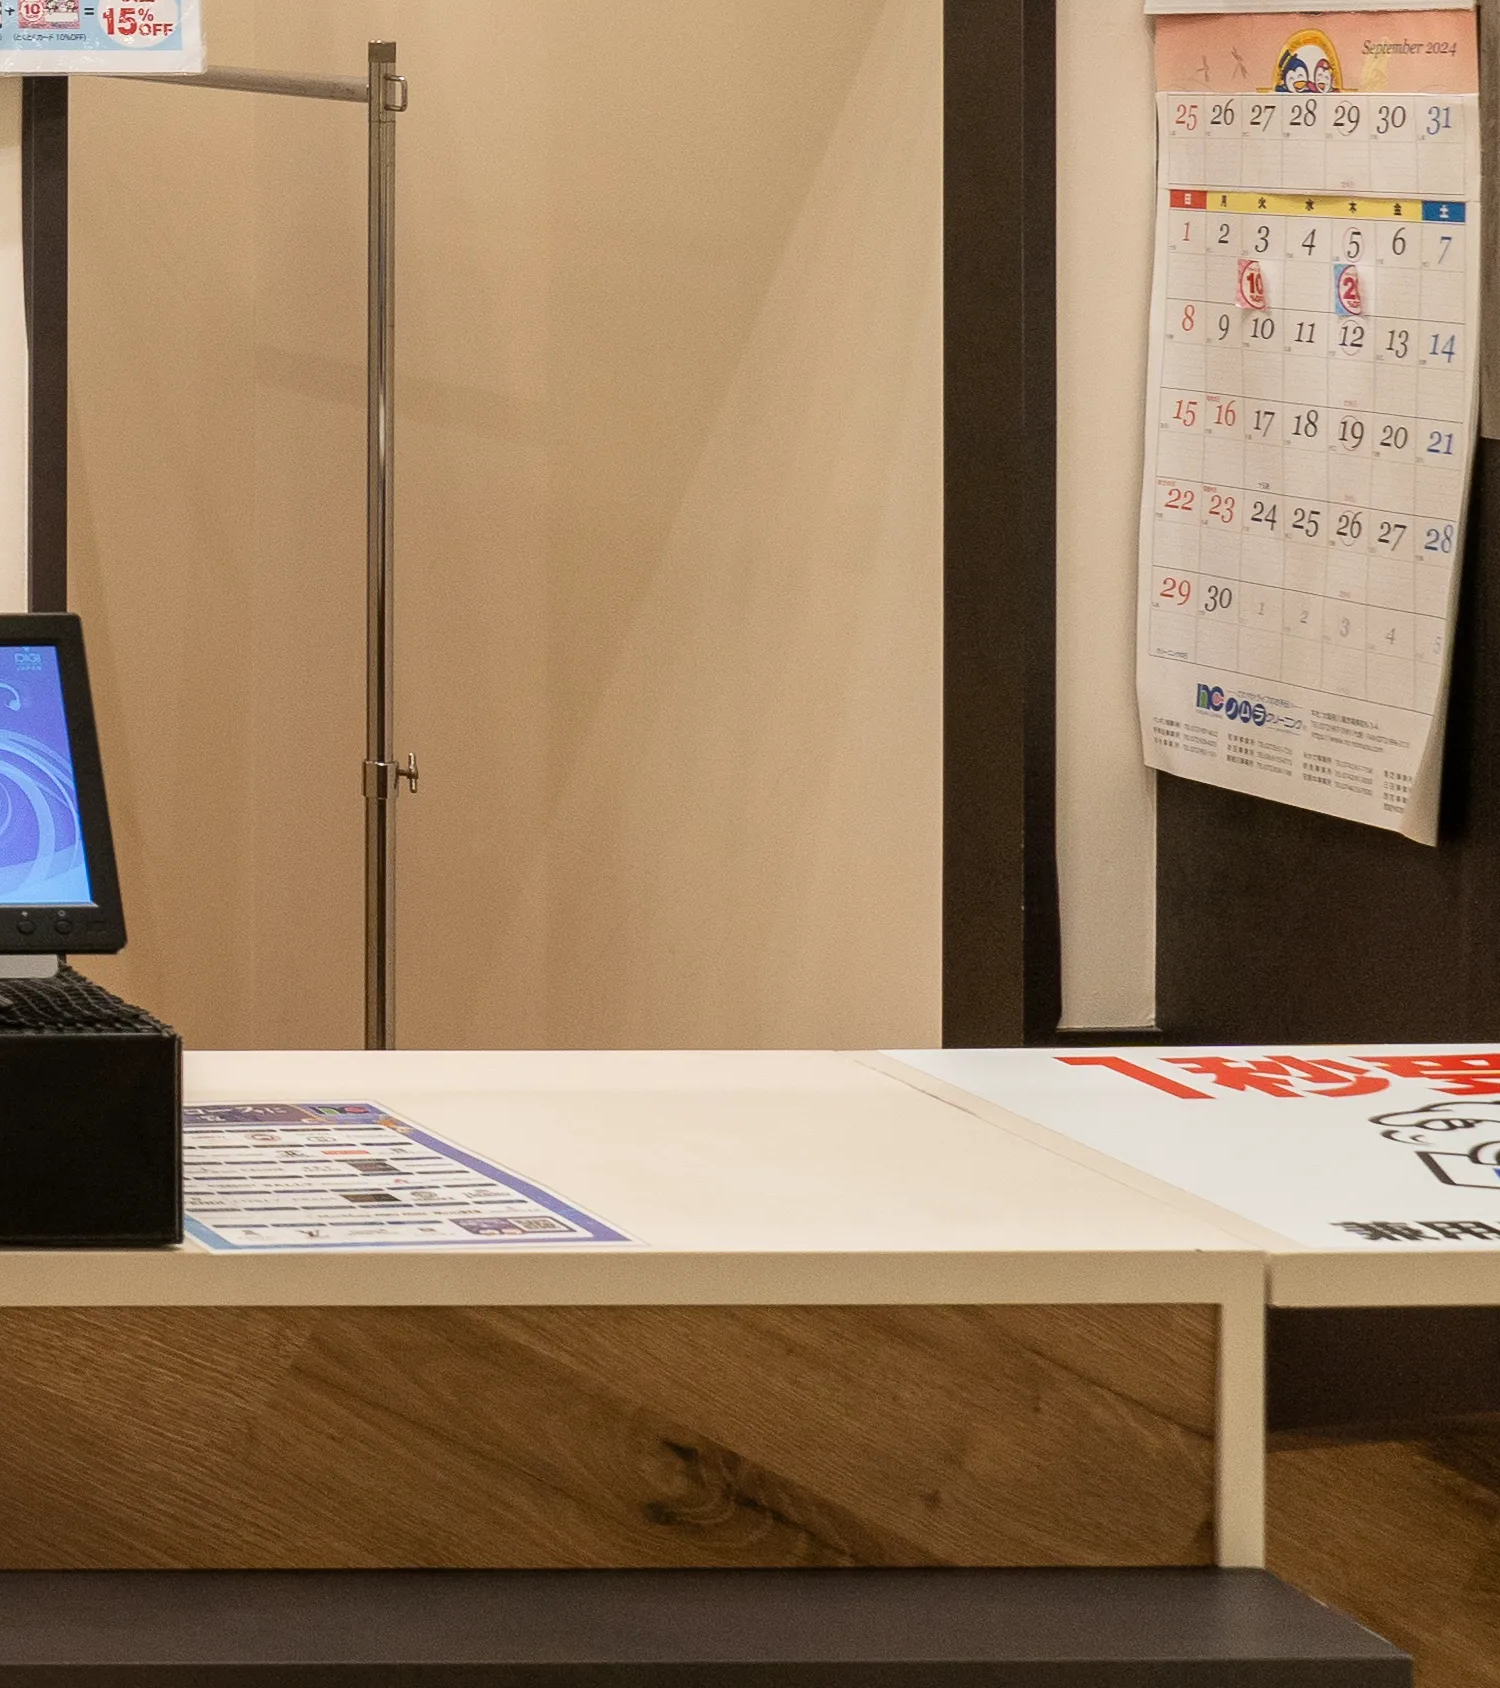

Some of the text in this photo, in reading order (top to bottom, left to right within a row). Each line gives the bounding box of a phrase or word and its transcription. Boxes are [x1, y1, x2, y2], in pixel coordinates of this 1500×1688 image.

[1362, 38, 1457, 57] September 2024
[1211, 99, 1406, 134] 26 30
[1292, 409, 1319, 438] 18
[1251, 501, 1277, 531] 24
